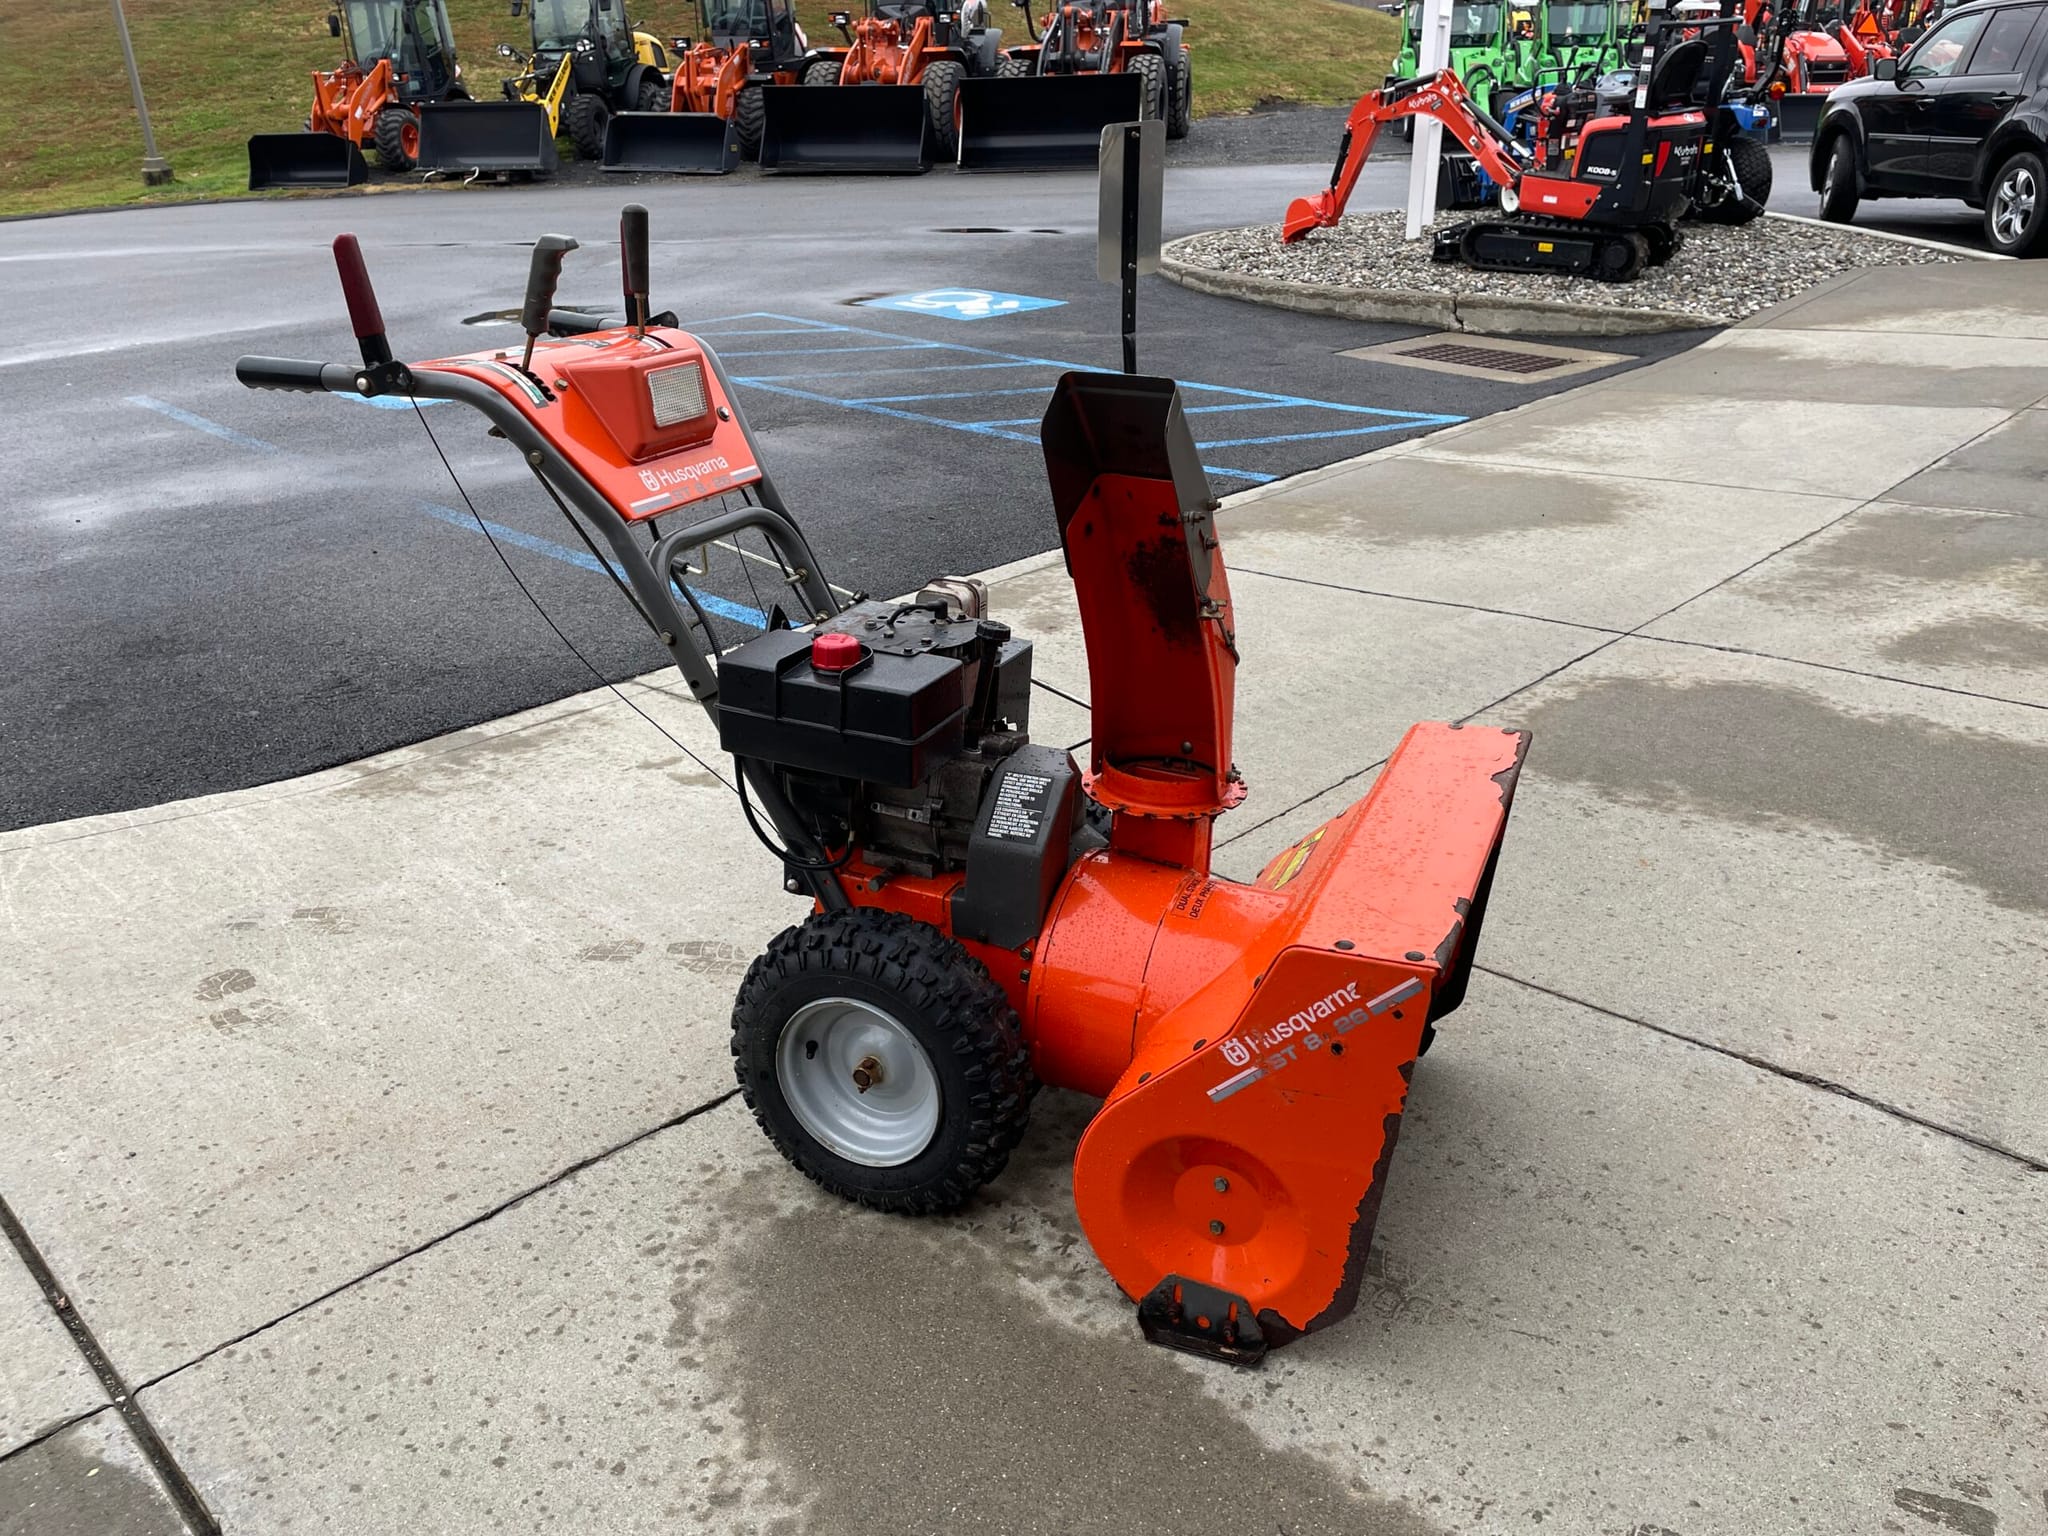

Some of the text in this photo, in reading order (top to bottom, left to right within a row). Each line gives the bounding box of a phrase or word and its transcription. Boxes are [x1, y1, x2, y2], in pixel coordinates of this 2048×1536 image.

[1408, 93, 1437, 109] Kubota
[655, 456, 728, 487] Husqvarna
[1189, 898, 1203, 918] DEUX
[1265, 1046, 1298, 1070] ST
[1333, 1008, 1369, 1034] 26
